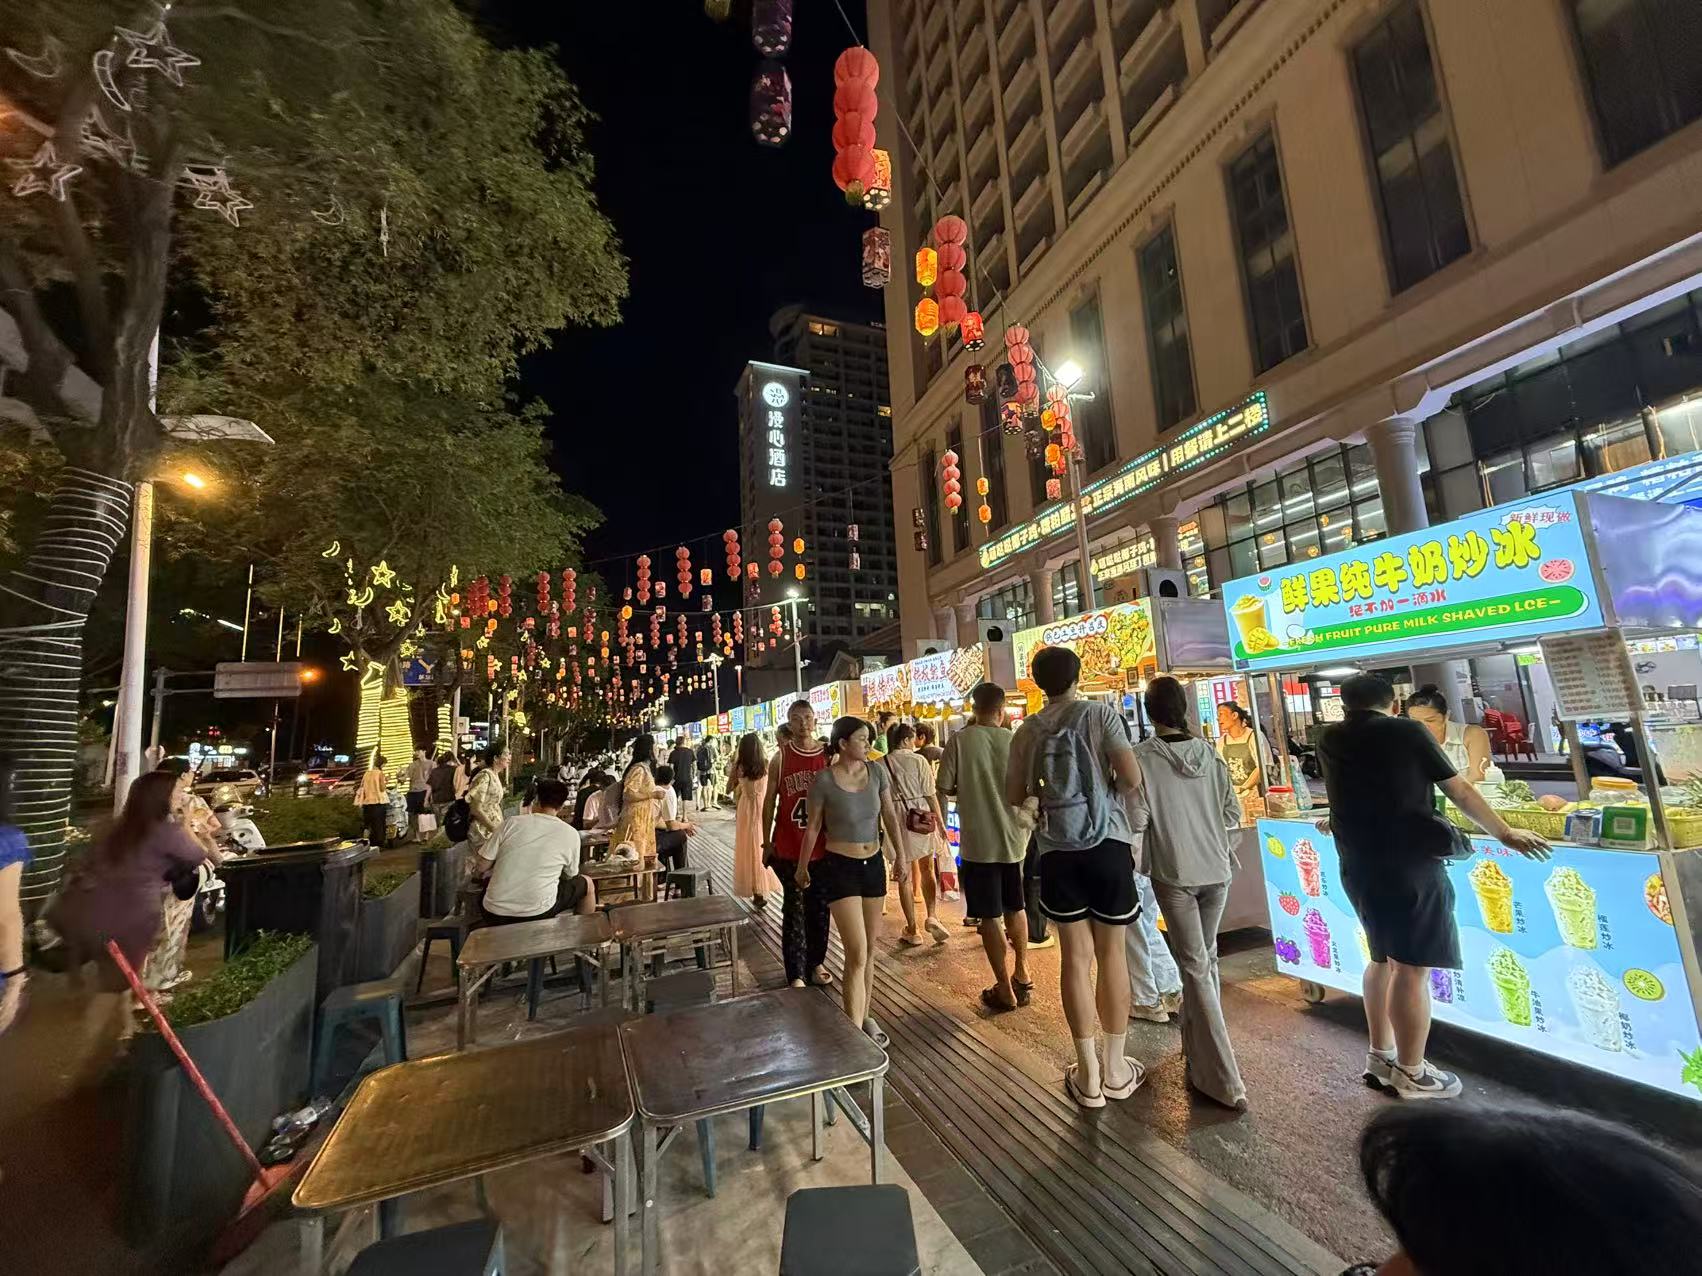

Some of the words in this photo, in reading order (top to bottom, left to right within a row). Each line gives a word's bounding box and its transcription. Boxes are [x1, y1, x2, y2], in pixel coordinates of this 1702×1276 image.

[1170, 402, 1263, 467] 用餐请上二楼
[1509, 511, 1571, 523] 新鲜现做
[1280, 520, 1541, 615] 鲜果纯牛奶炒冰
[1349, 589, 1447, 617] 绝不加一滴水
[1326, 628, 1361, 640] FRUIT
[1364, 622, 1400, 635] PURE
[1403, 614, 1438, 629] MILK
[1442, 604, 1510, 623] SHAVED
[1513, 901, 1528, 934] 芒果炒冰
[1531, 990, 1547, 1033] 牛油果炒冰
